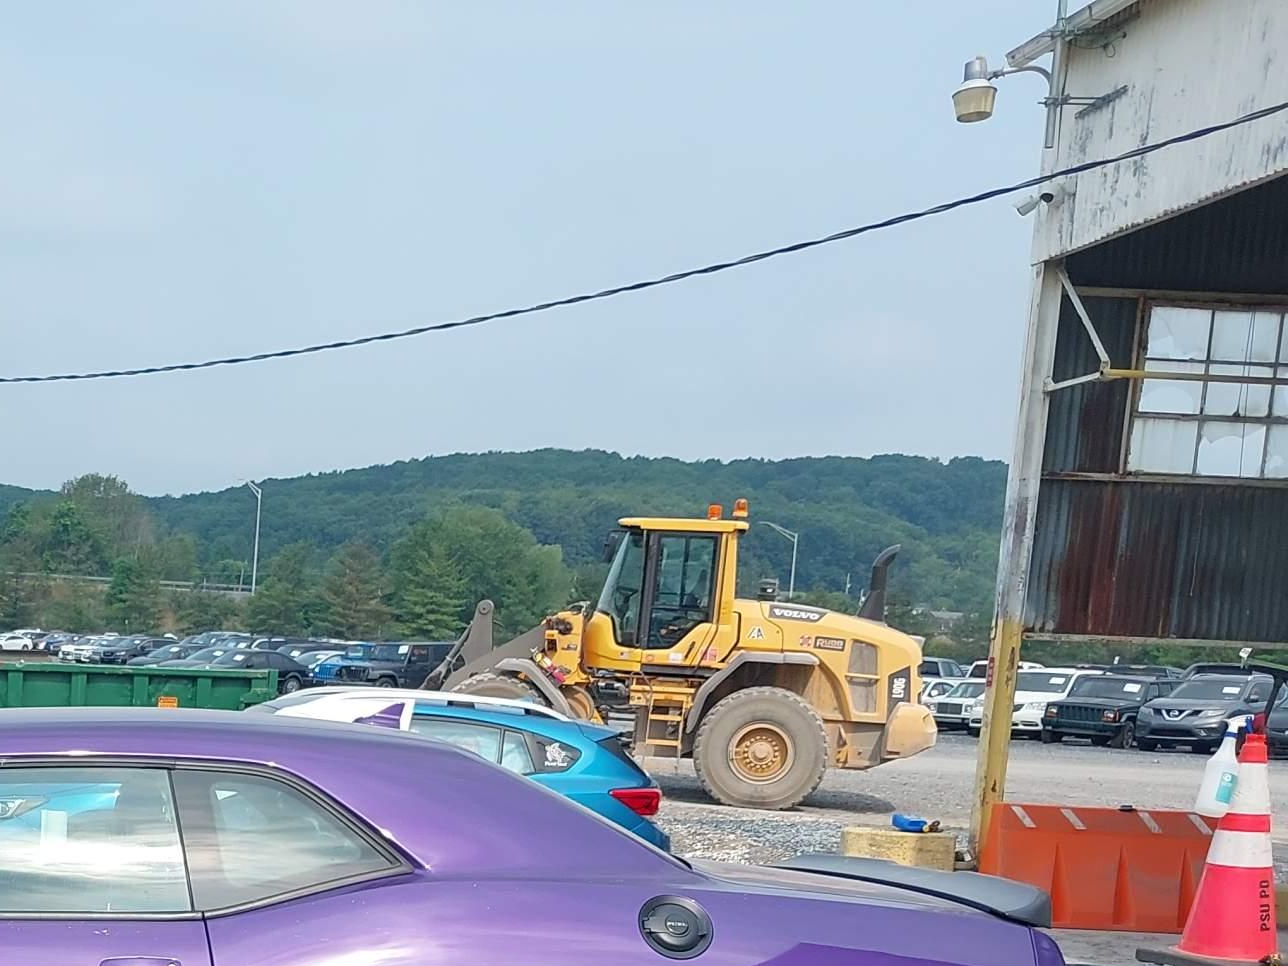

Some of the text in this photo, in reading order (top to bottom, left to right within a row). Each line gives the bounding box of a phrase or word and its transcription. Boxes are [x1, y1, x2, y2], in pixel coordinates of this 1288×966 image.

[773, 608, 819, 620] VOLVO
[892, 677, 906, 698] L90G
[1259, 880, 1270, 932] PSU PD
